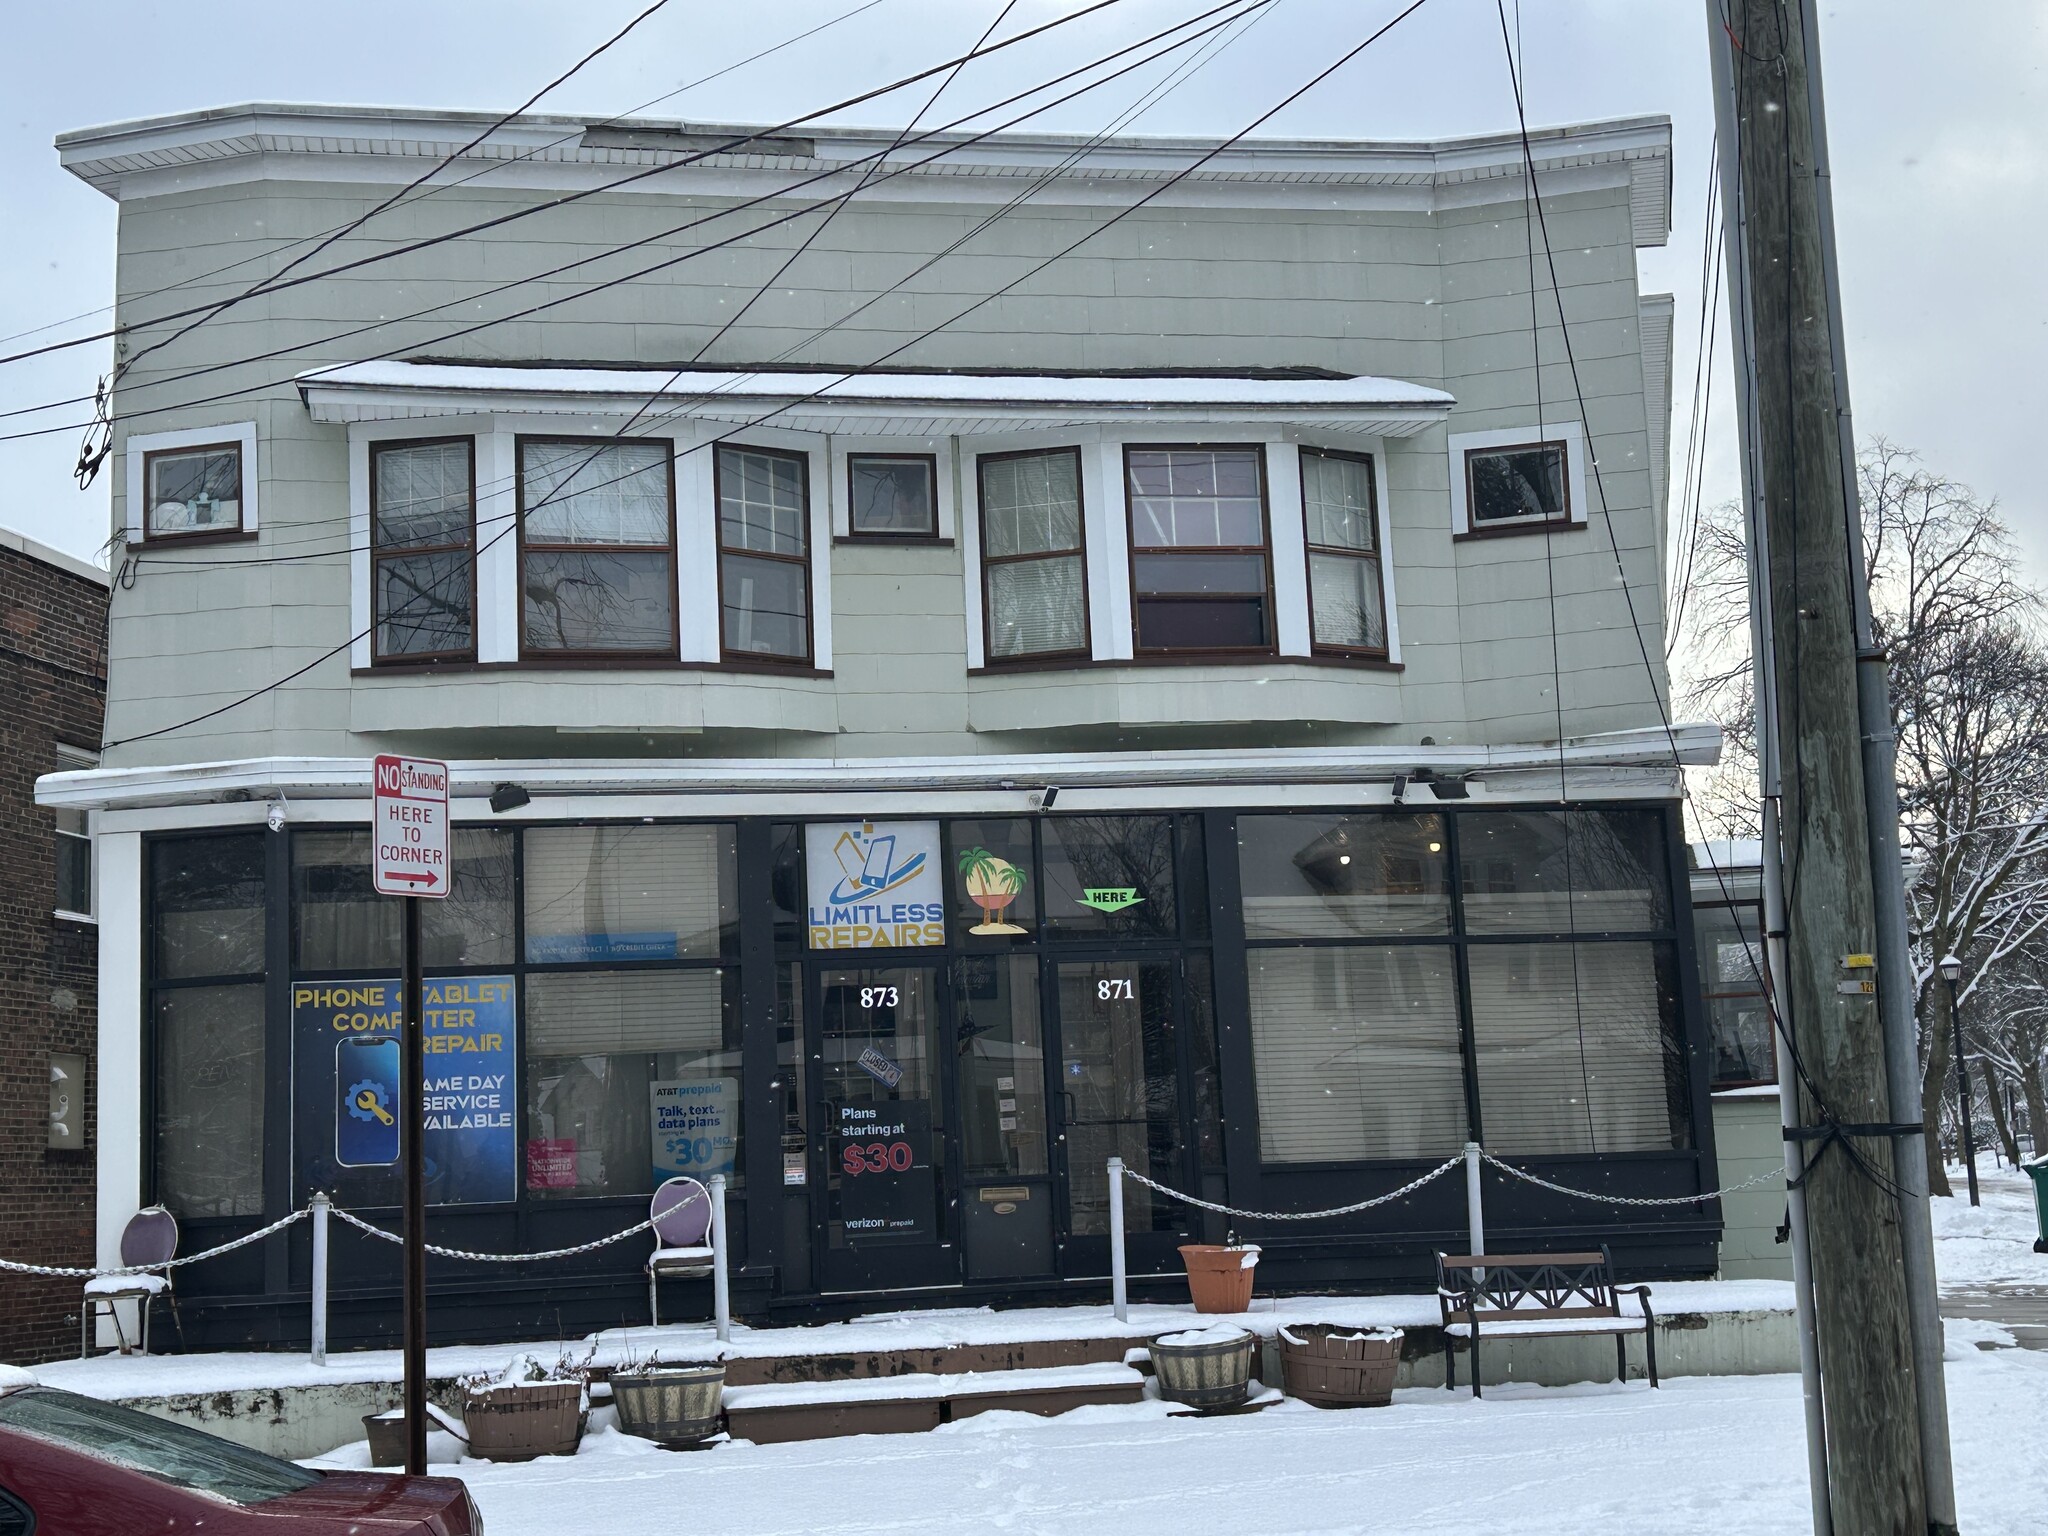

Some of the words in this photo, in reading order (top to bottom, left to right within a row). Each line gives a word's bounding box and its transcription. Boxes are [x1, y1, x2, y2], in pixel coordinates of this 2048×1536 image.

[378, 764, 400, 790] NO
[401, 770, 444, 791] STANDING
[390, 805, 432, 824] HERE
[402, 826, 421, 842] TO
[380, 845, 442, 864] CORNER
[1093, 892, 1127, 903] HERE
[810, 903, 943, 925] LIMITLESS
[810, 923, 945, 949] REPAIRS
[295, 987, 385, 1009] PHONE
[860, 986, 899, 1009] 873
[1097, 979, 1135, 1000] 871
[332, 1008, 476, 1032] COMPTER
[468, 1074, 505, 1090] DAY
[656, 1087, 679, 1096] AT&T
[679, 1083, 722, 1097] prepaid
[657, 1105, 687, 1117] Talk,
[688, 1104, 715, 1116] text
[841, 1107, 877, 1120] Plans
[658, 1118, 686, 1129] data
[688, 1116, 720, 1130] plans
[842, 1123, 891, 1137] starting
[892, 1122, 905, 1134] at
[666, 1136, 713, 1166] $30
[843, 1141, 913, 1177] $30
[845, 1217, 885, 1229] verizon
[889, 1219, 914, 1227] prepaid
